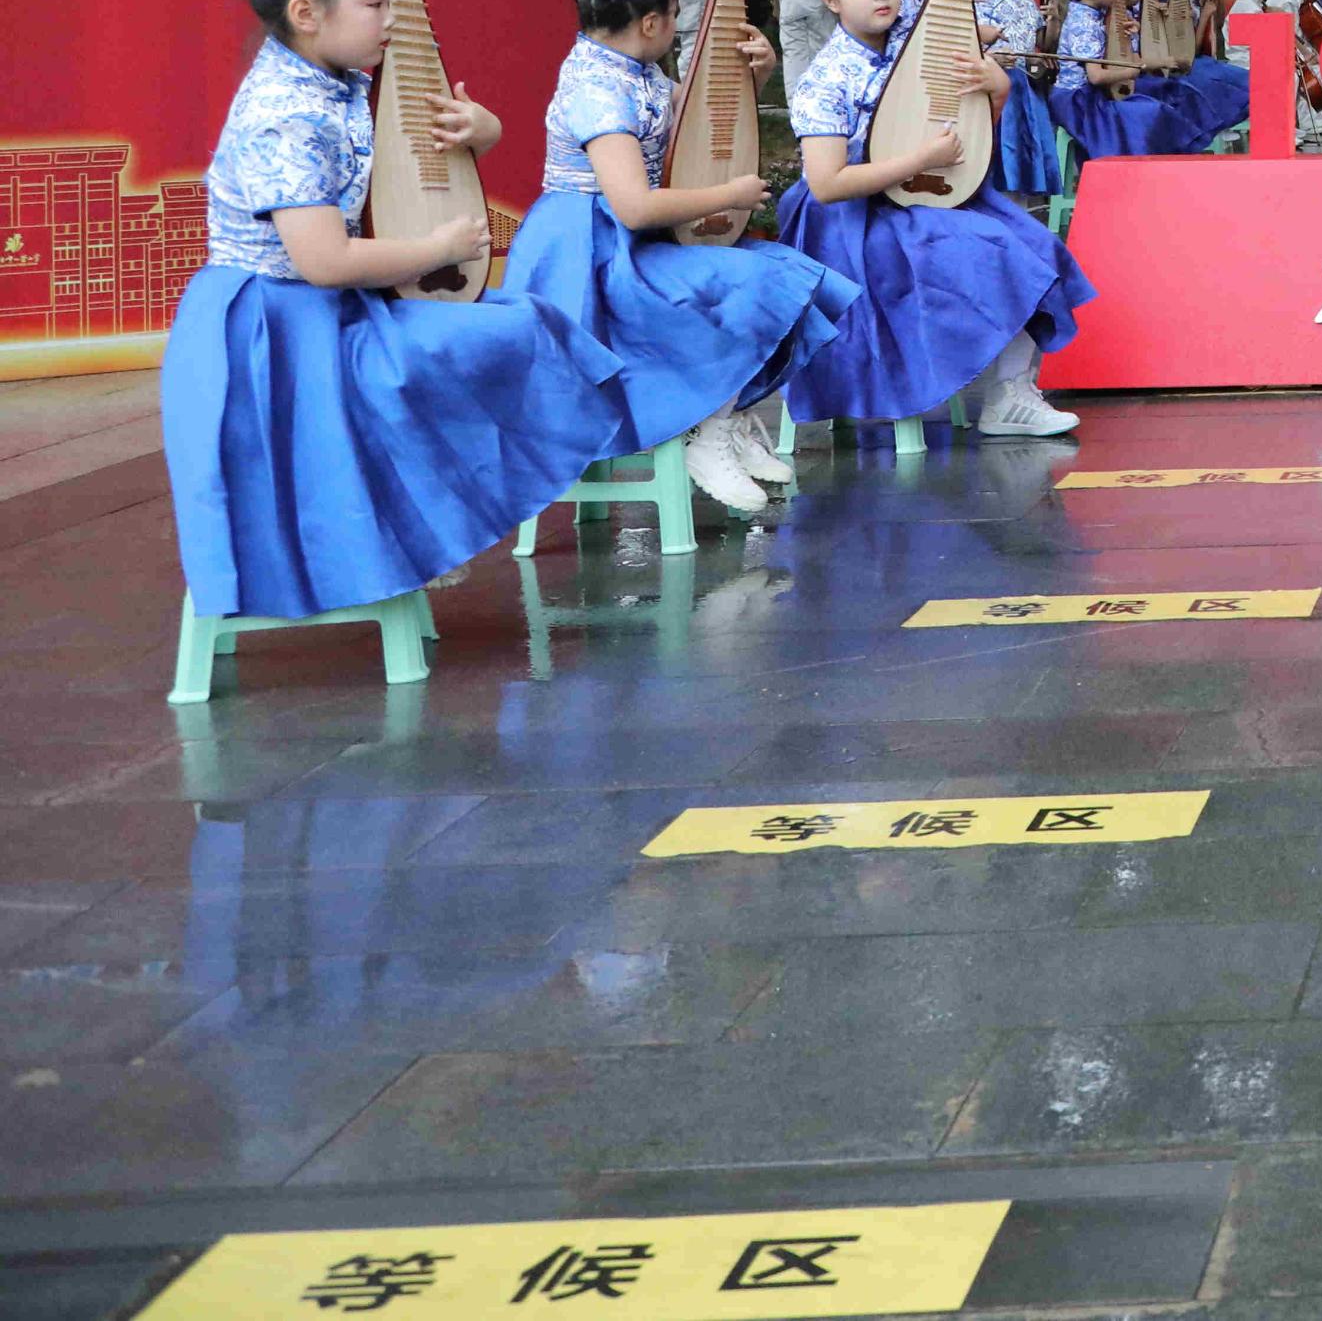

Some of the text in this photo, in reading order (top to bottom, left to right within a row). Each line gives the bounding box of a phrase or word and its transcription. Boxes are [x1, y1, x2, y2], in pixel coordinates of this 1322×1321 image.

[982, 597, 1252, 619] 等候区
[750, 805, 1115, 842] 等候区
[299, 1233, 862, 1313] 等候区
